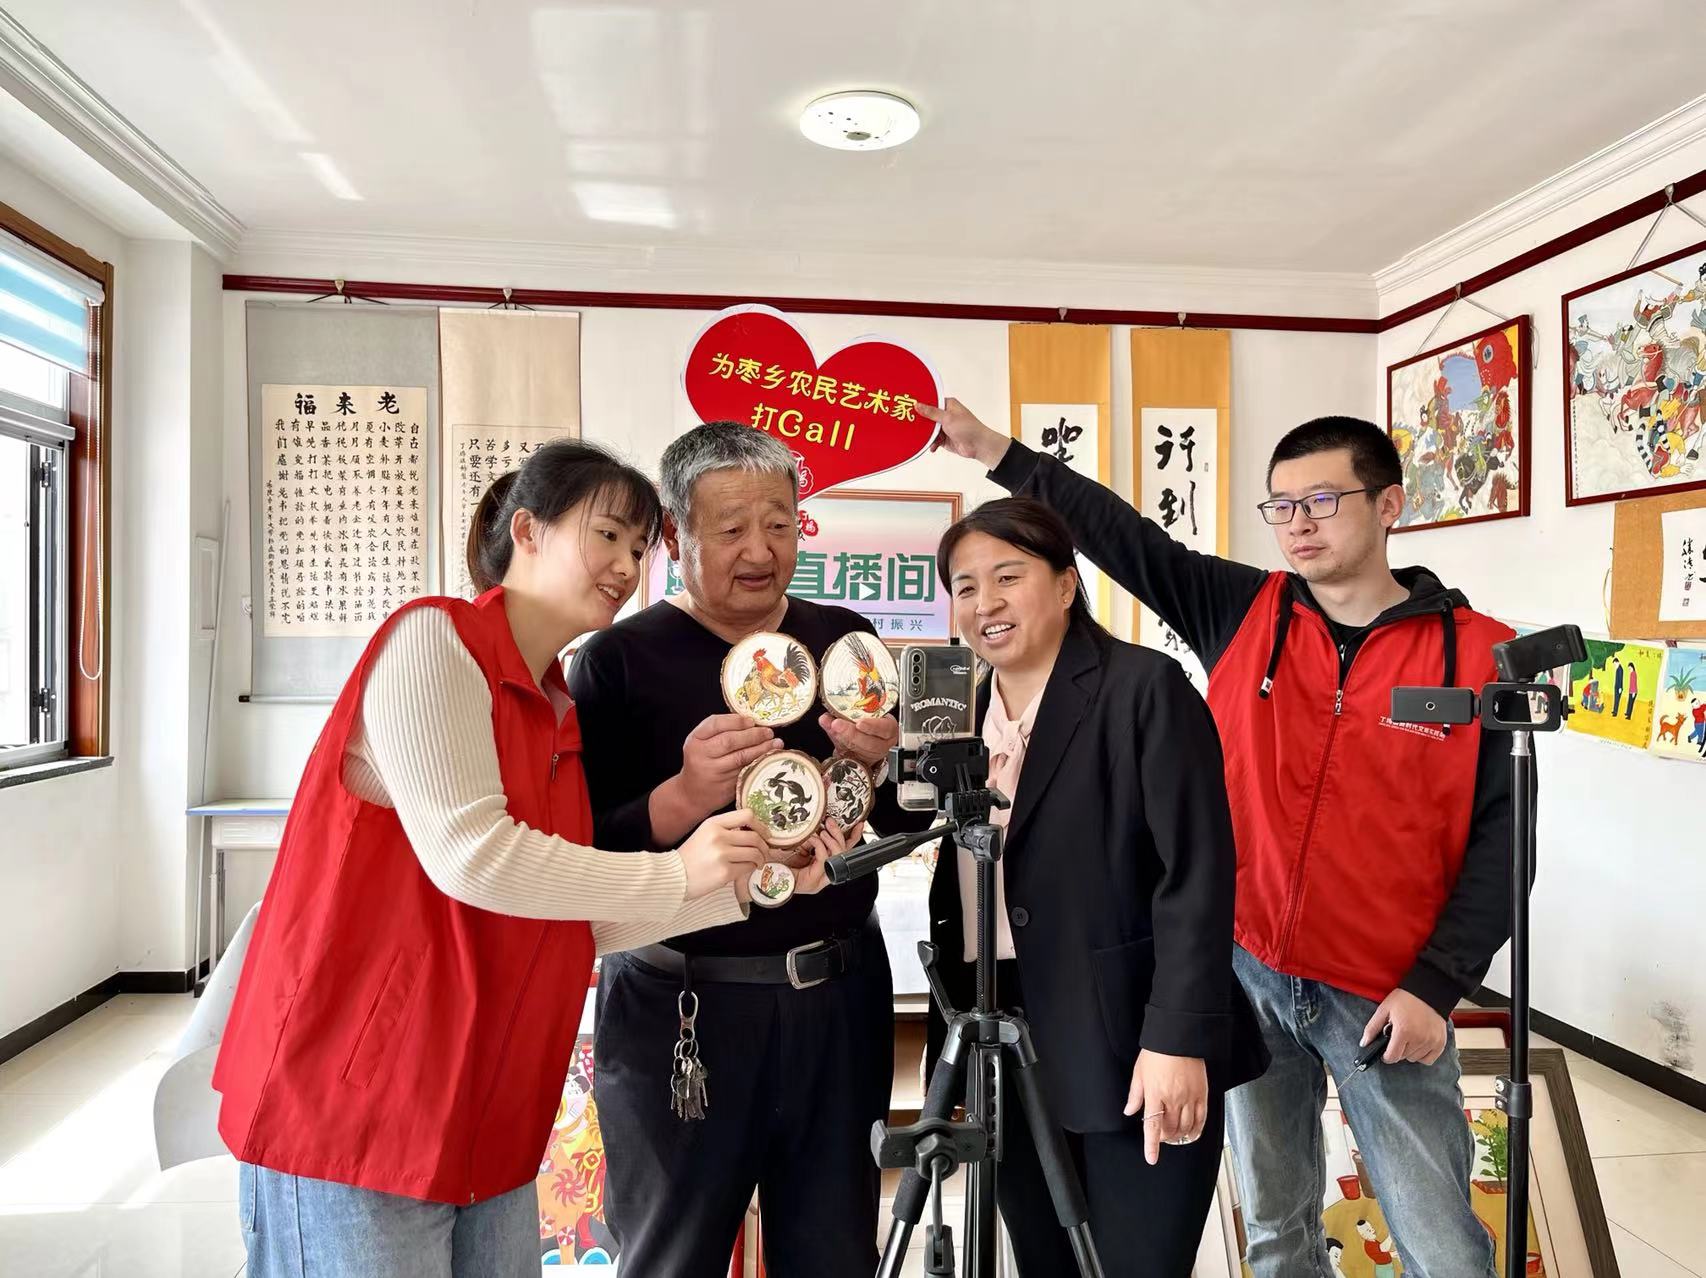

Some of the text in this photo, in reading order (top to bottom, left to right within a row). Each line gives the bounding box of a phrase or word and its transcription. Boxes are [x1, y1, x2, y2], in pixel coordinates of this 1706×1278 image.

[709, 353, 917, 422] 为枣乡农民艺术家
[751, 403, 855, 450] 打Call
[787, 551, 936, 602] 直播间
